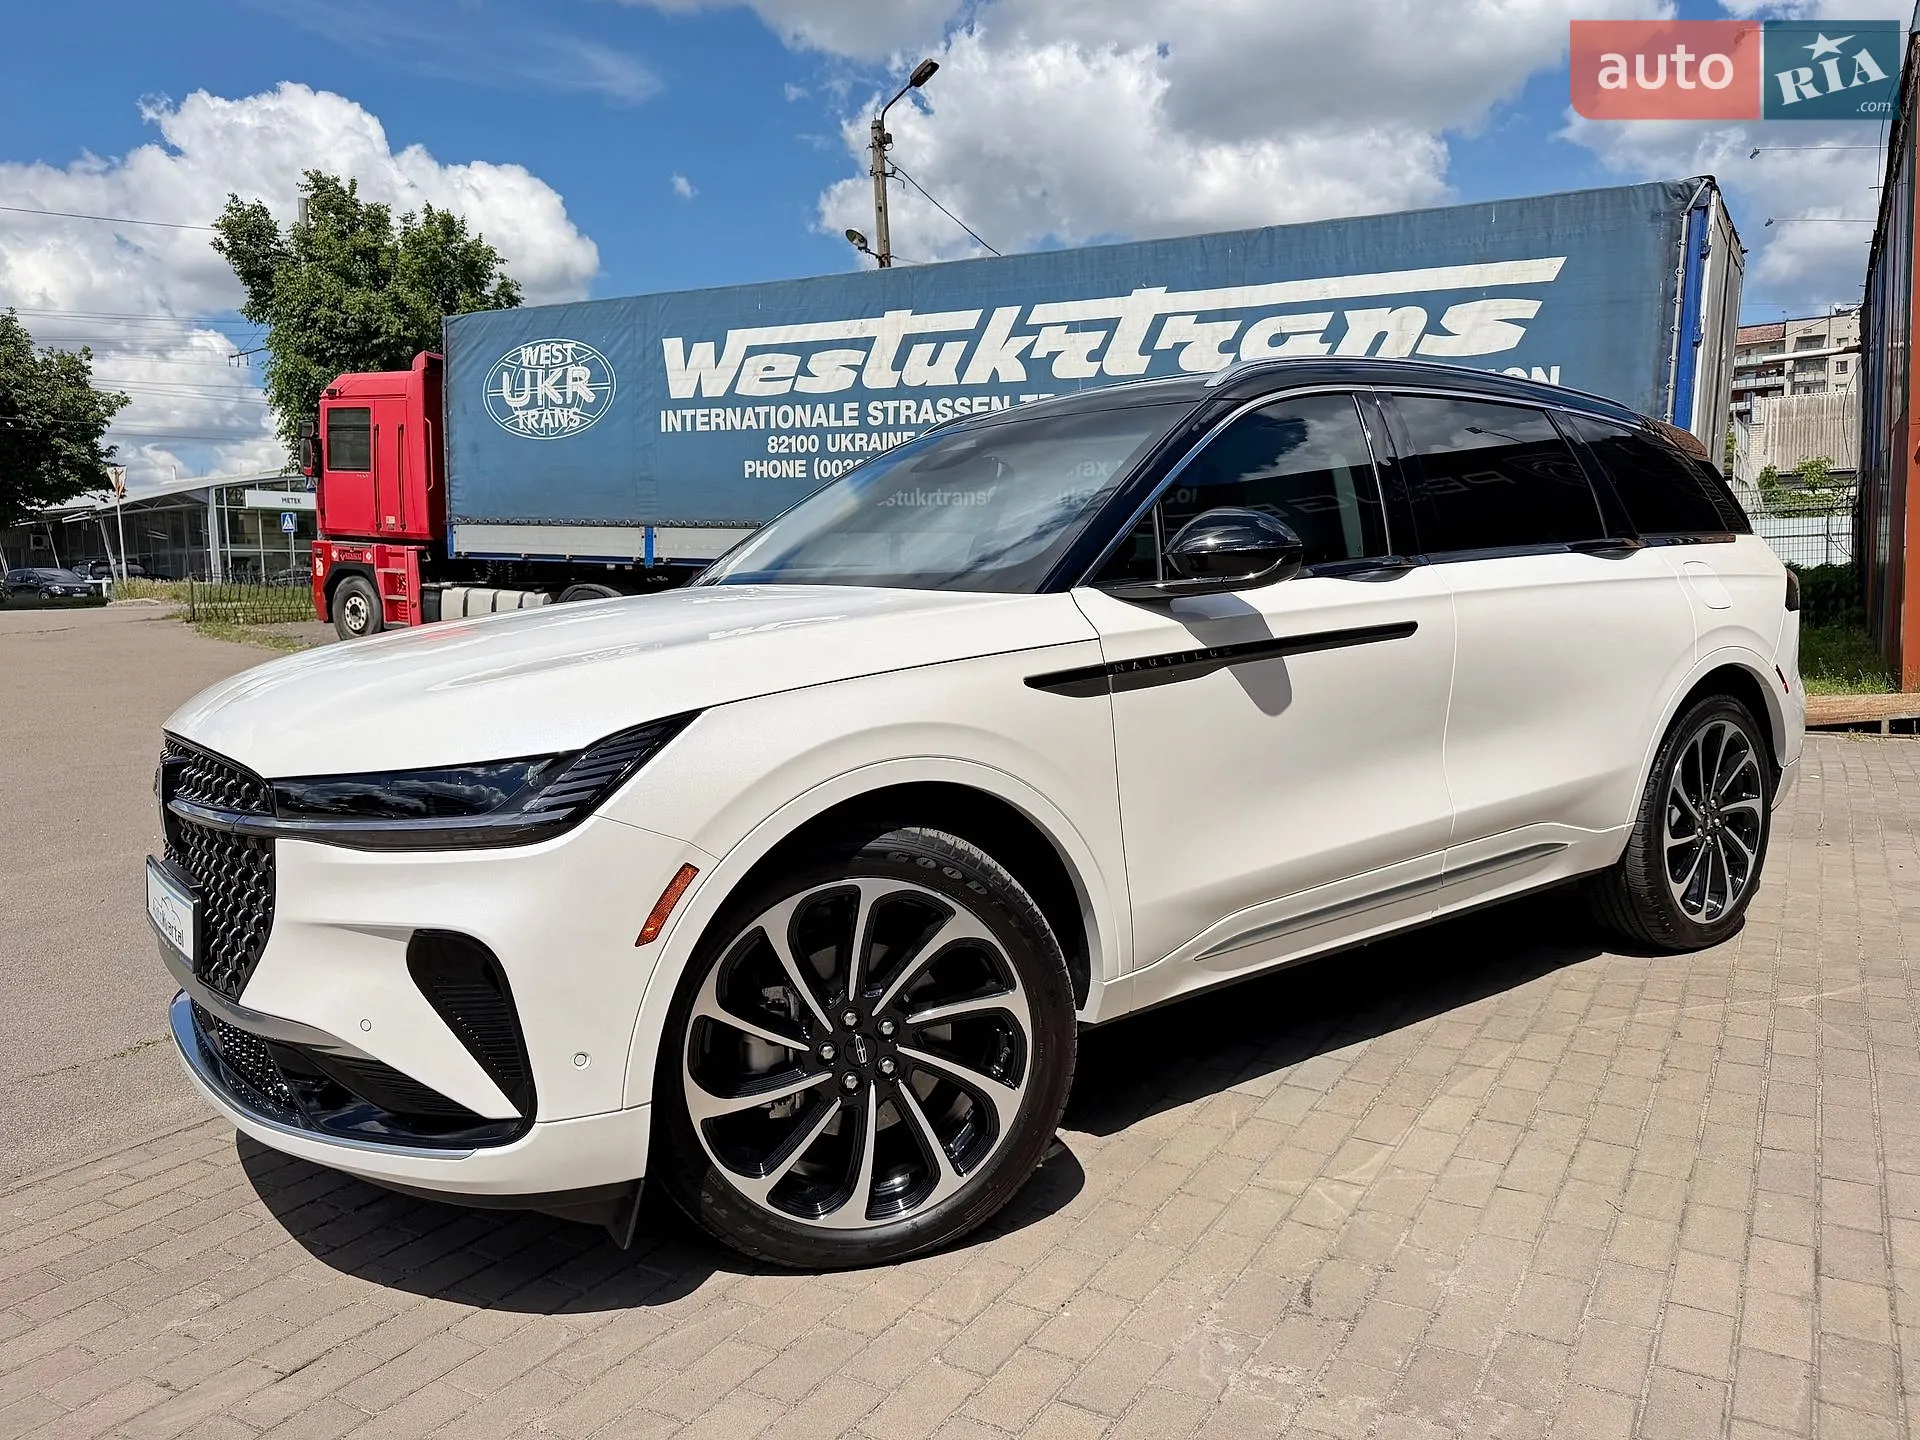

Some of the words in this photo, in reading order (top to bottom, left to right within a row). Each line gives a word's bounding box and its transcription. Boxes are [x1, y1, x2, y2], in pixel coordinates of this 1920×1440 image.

[520, 343, 577, 366] WEST
[502, 366, 596, 407] UKR
[516, 407, 580, 429] TRANS
[660, 402, 860, 432] INTERNATIONALE
[767, 435, 819, 454] 82100
[744, 459, 806, 479] PHONE
[1114, 647, 1233, 673] NAUTILUS
